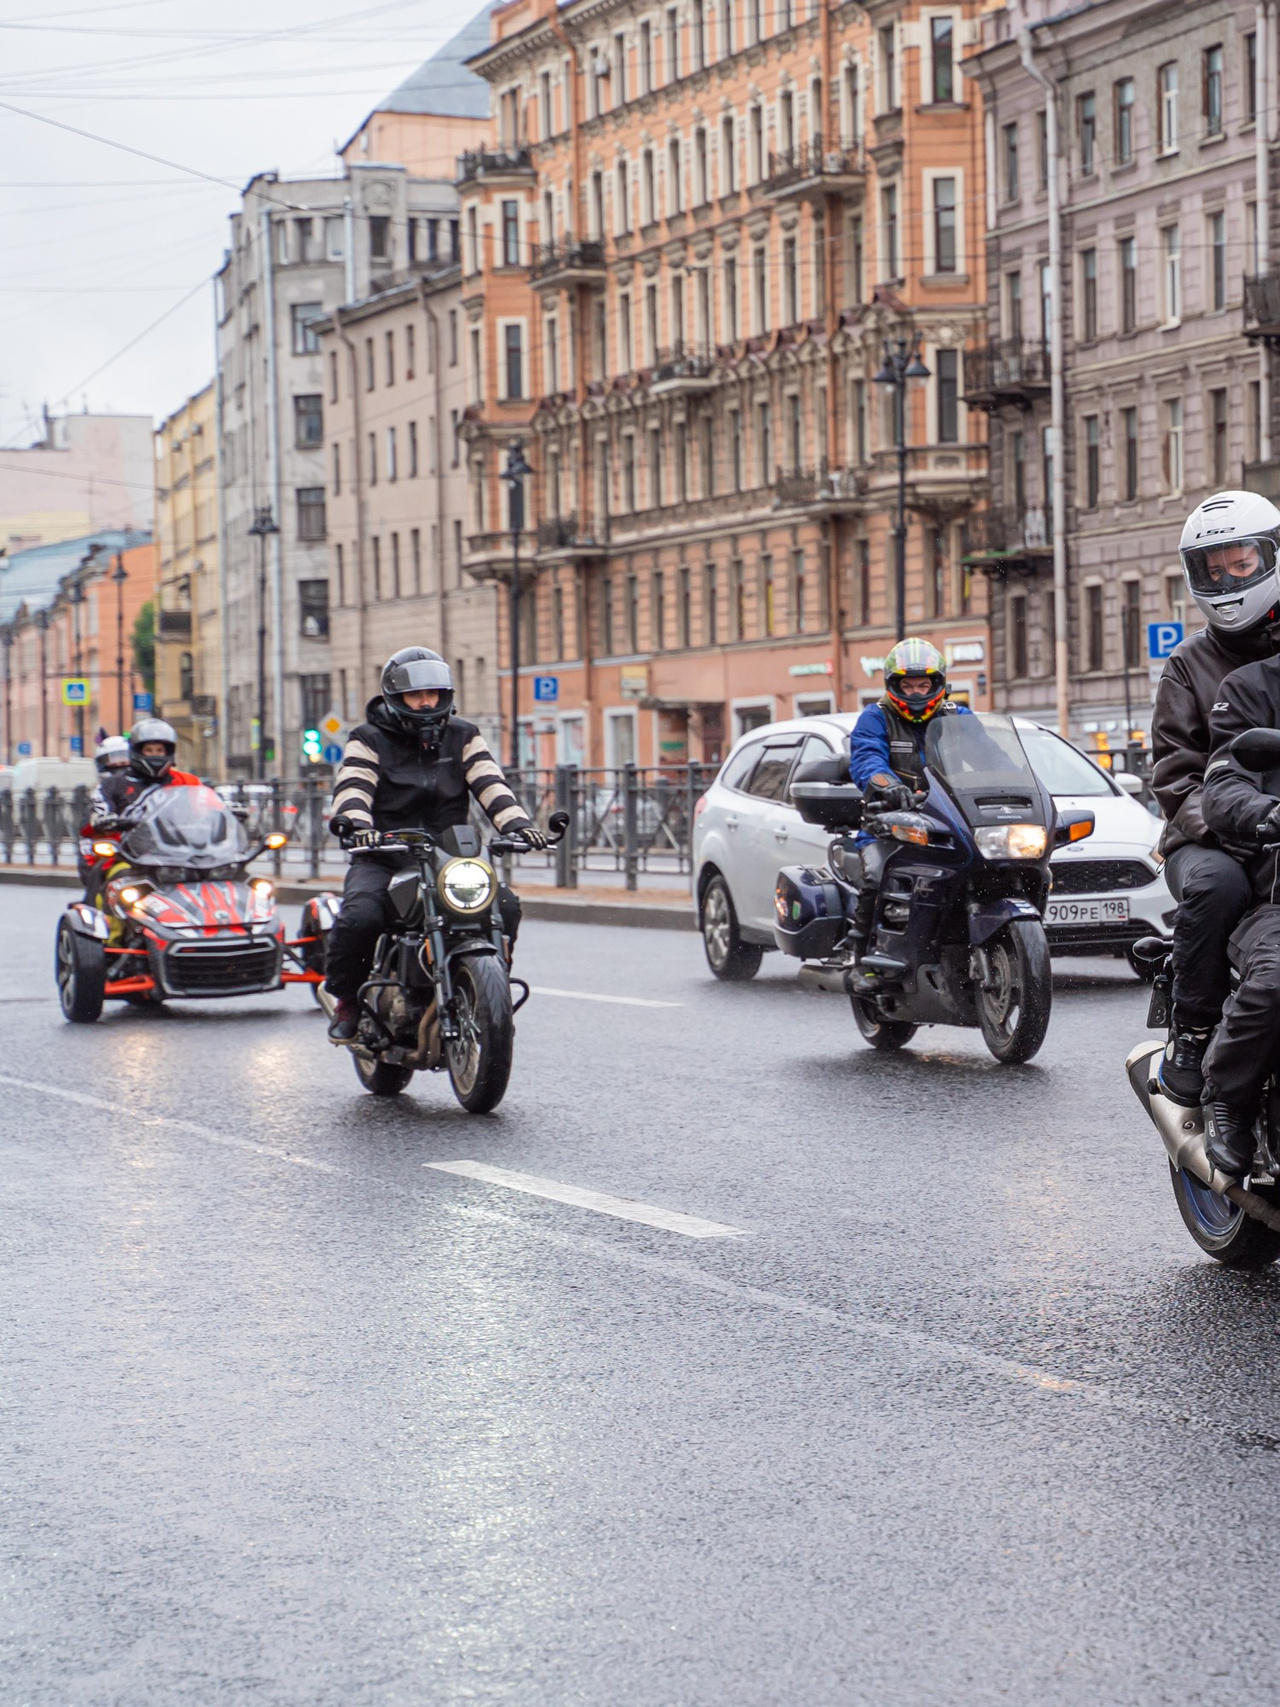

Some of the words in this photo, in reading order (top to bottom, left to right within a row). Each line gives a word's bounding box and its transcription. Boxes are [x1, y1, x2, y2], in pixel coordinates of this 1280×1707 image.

[1196, 526, 1236, 539] LS2
[1045, 905, 1098, 921] 909РЕ
[1103, 902, 1124, 914] 198
